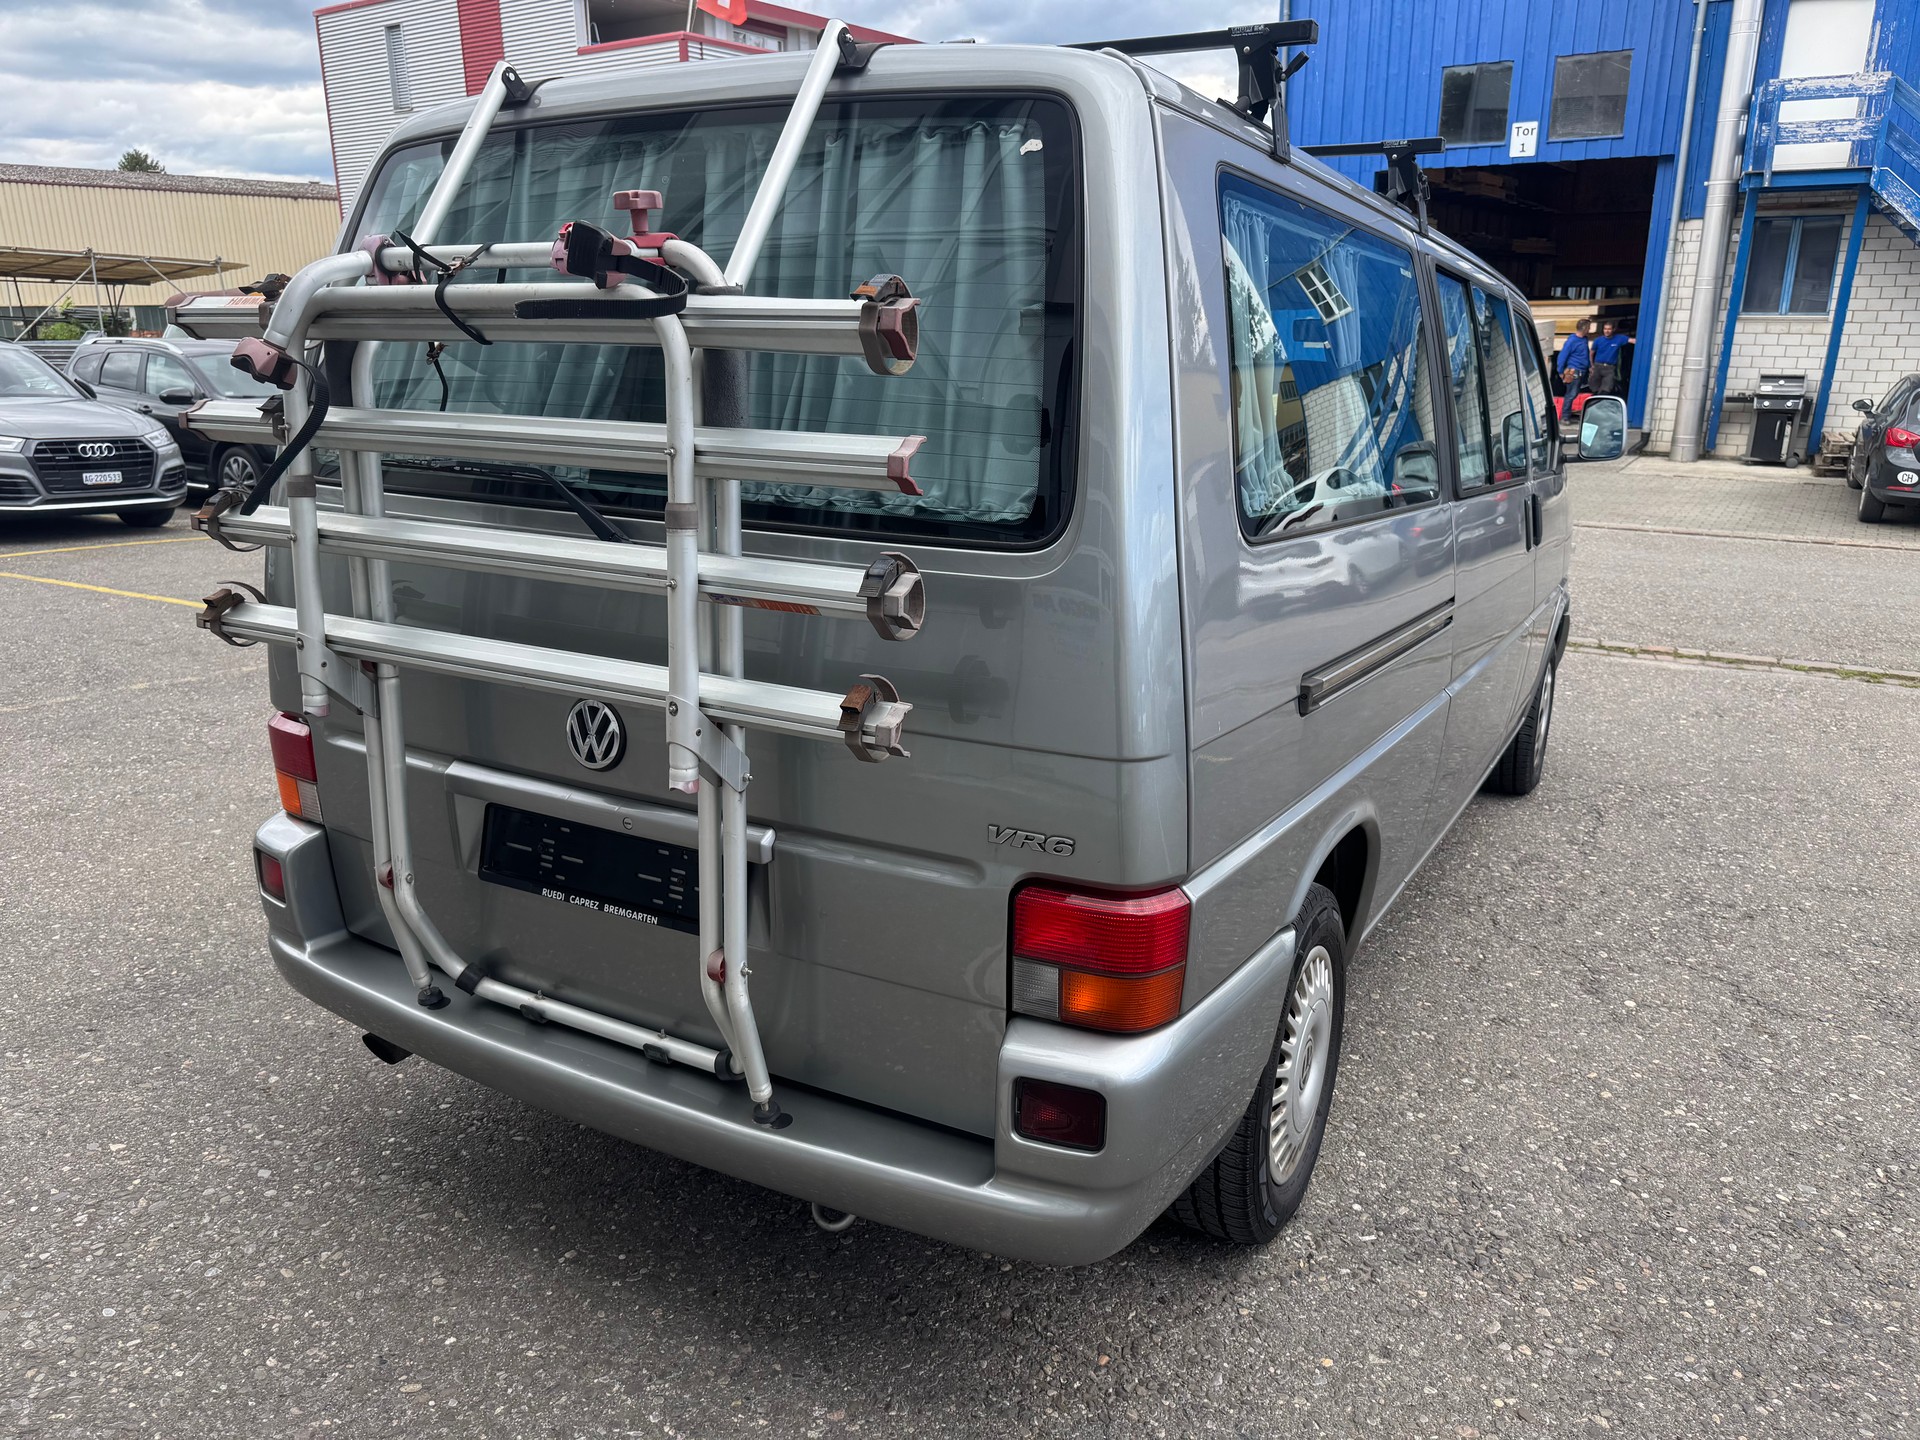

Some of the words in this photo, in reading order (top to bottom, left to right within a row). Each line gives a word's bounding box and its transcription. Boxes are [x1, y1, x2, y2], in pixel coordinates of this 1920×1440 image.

[1515, 126, 1536, 137] Tor
[1519, 142, 1526, 153] 1
[1901, 473, 1913, 483] CH
[988, 824, 1076, 857] VR6
[541, 887, 566, 901] RUEDI
[569, 895, 600, 910] CAPREZ
[603, 903, 659, 925] BREMGARTEN
